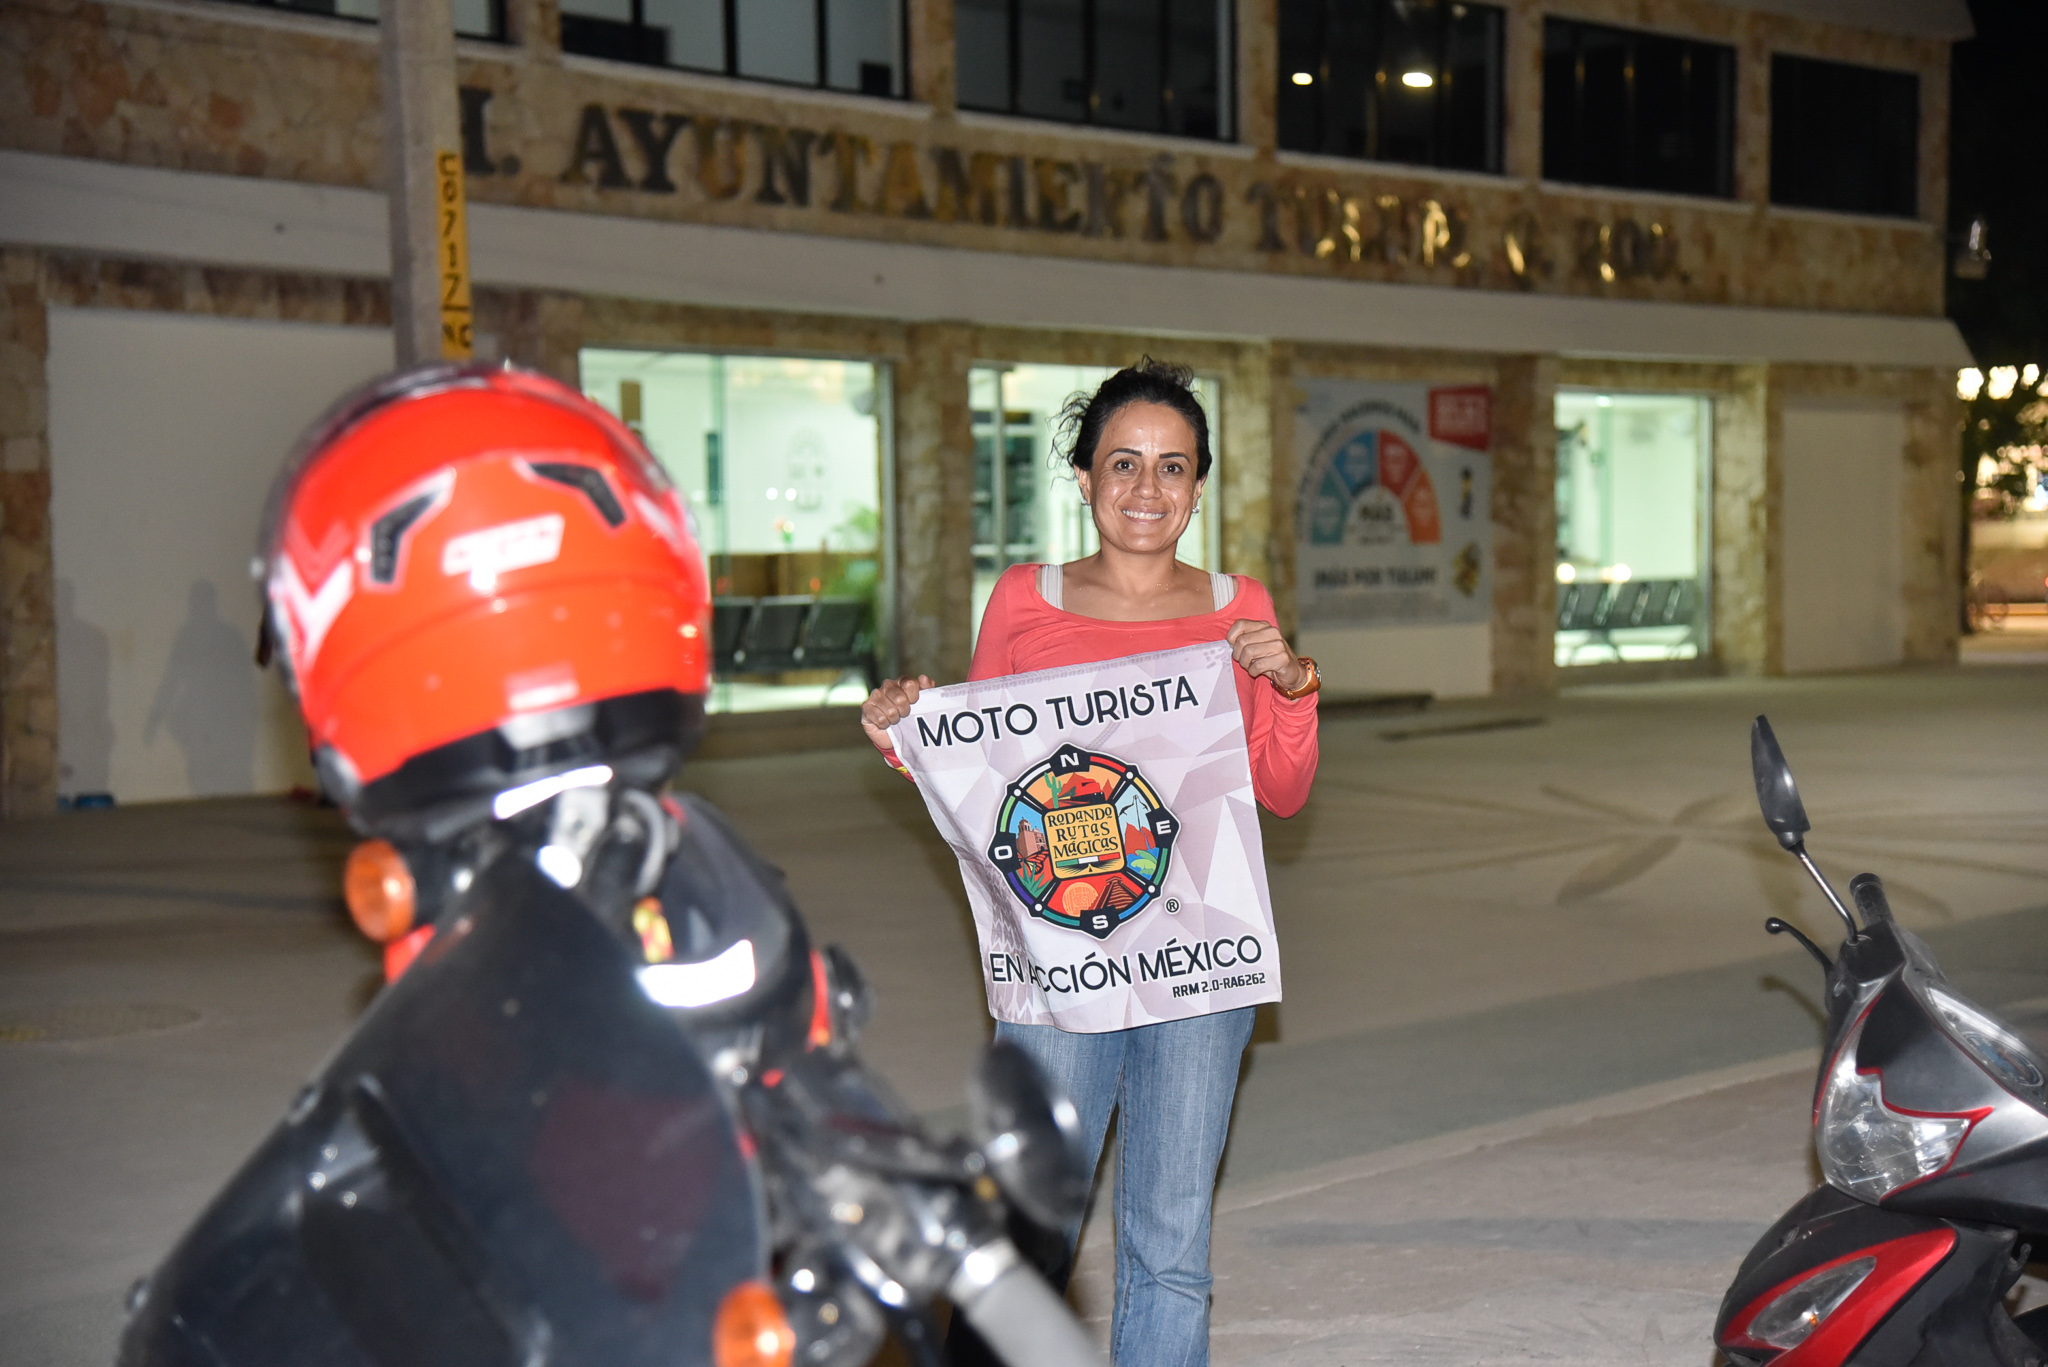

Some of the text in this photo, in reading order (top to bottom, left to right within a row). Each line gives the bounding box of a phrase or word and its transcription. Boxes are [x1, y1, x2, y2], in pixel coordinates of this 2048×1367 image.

[559, 102, 1225, 244] AYUNTAMIENTO
[916, 675, 1199, 748] MOTO TURISTA
[1060, 752, 1080, 768] N
[1155, 820, 1172, 835] E
[1092, 914, 1109, 930] S
[989, 935, 1263, 994] EN ACCIÓN MÉXICO
[1172, 972, 1266, 998] RRM 2.0-RA6262
